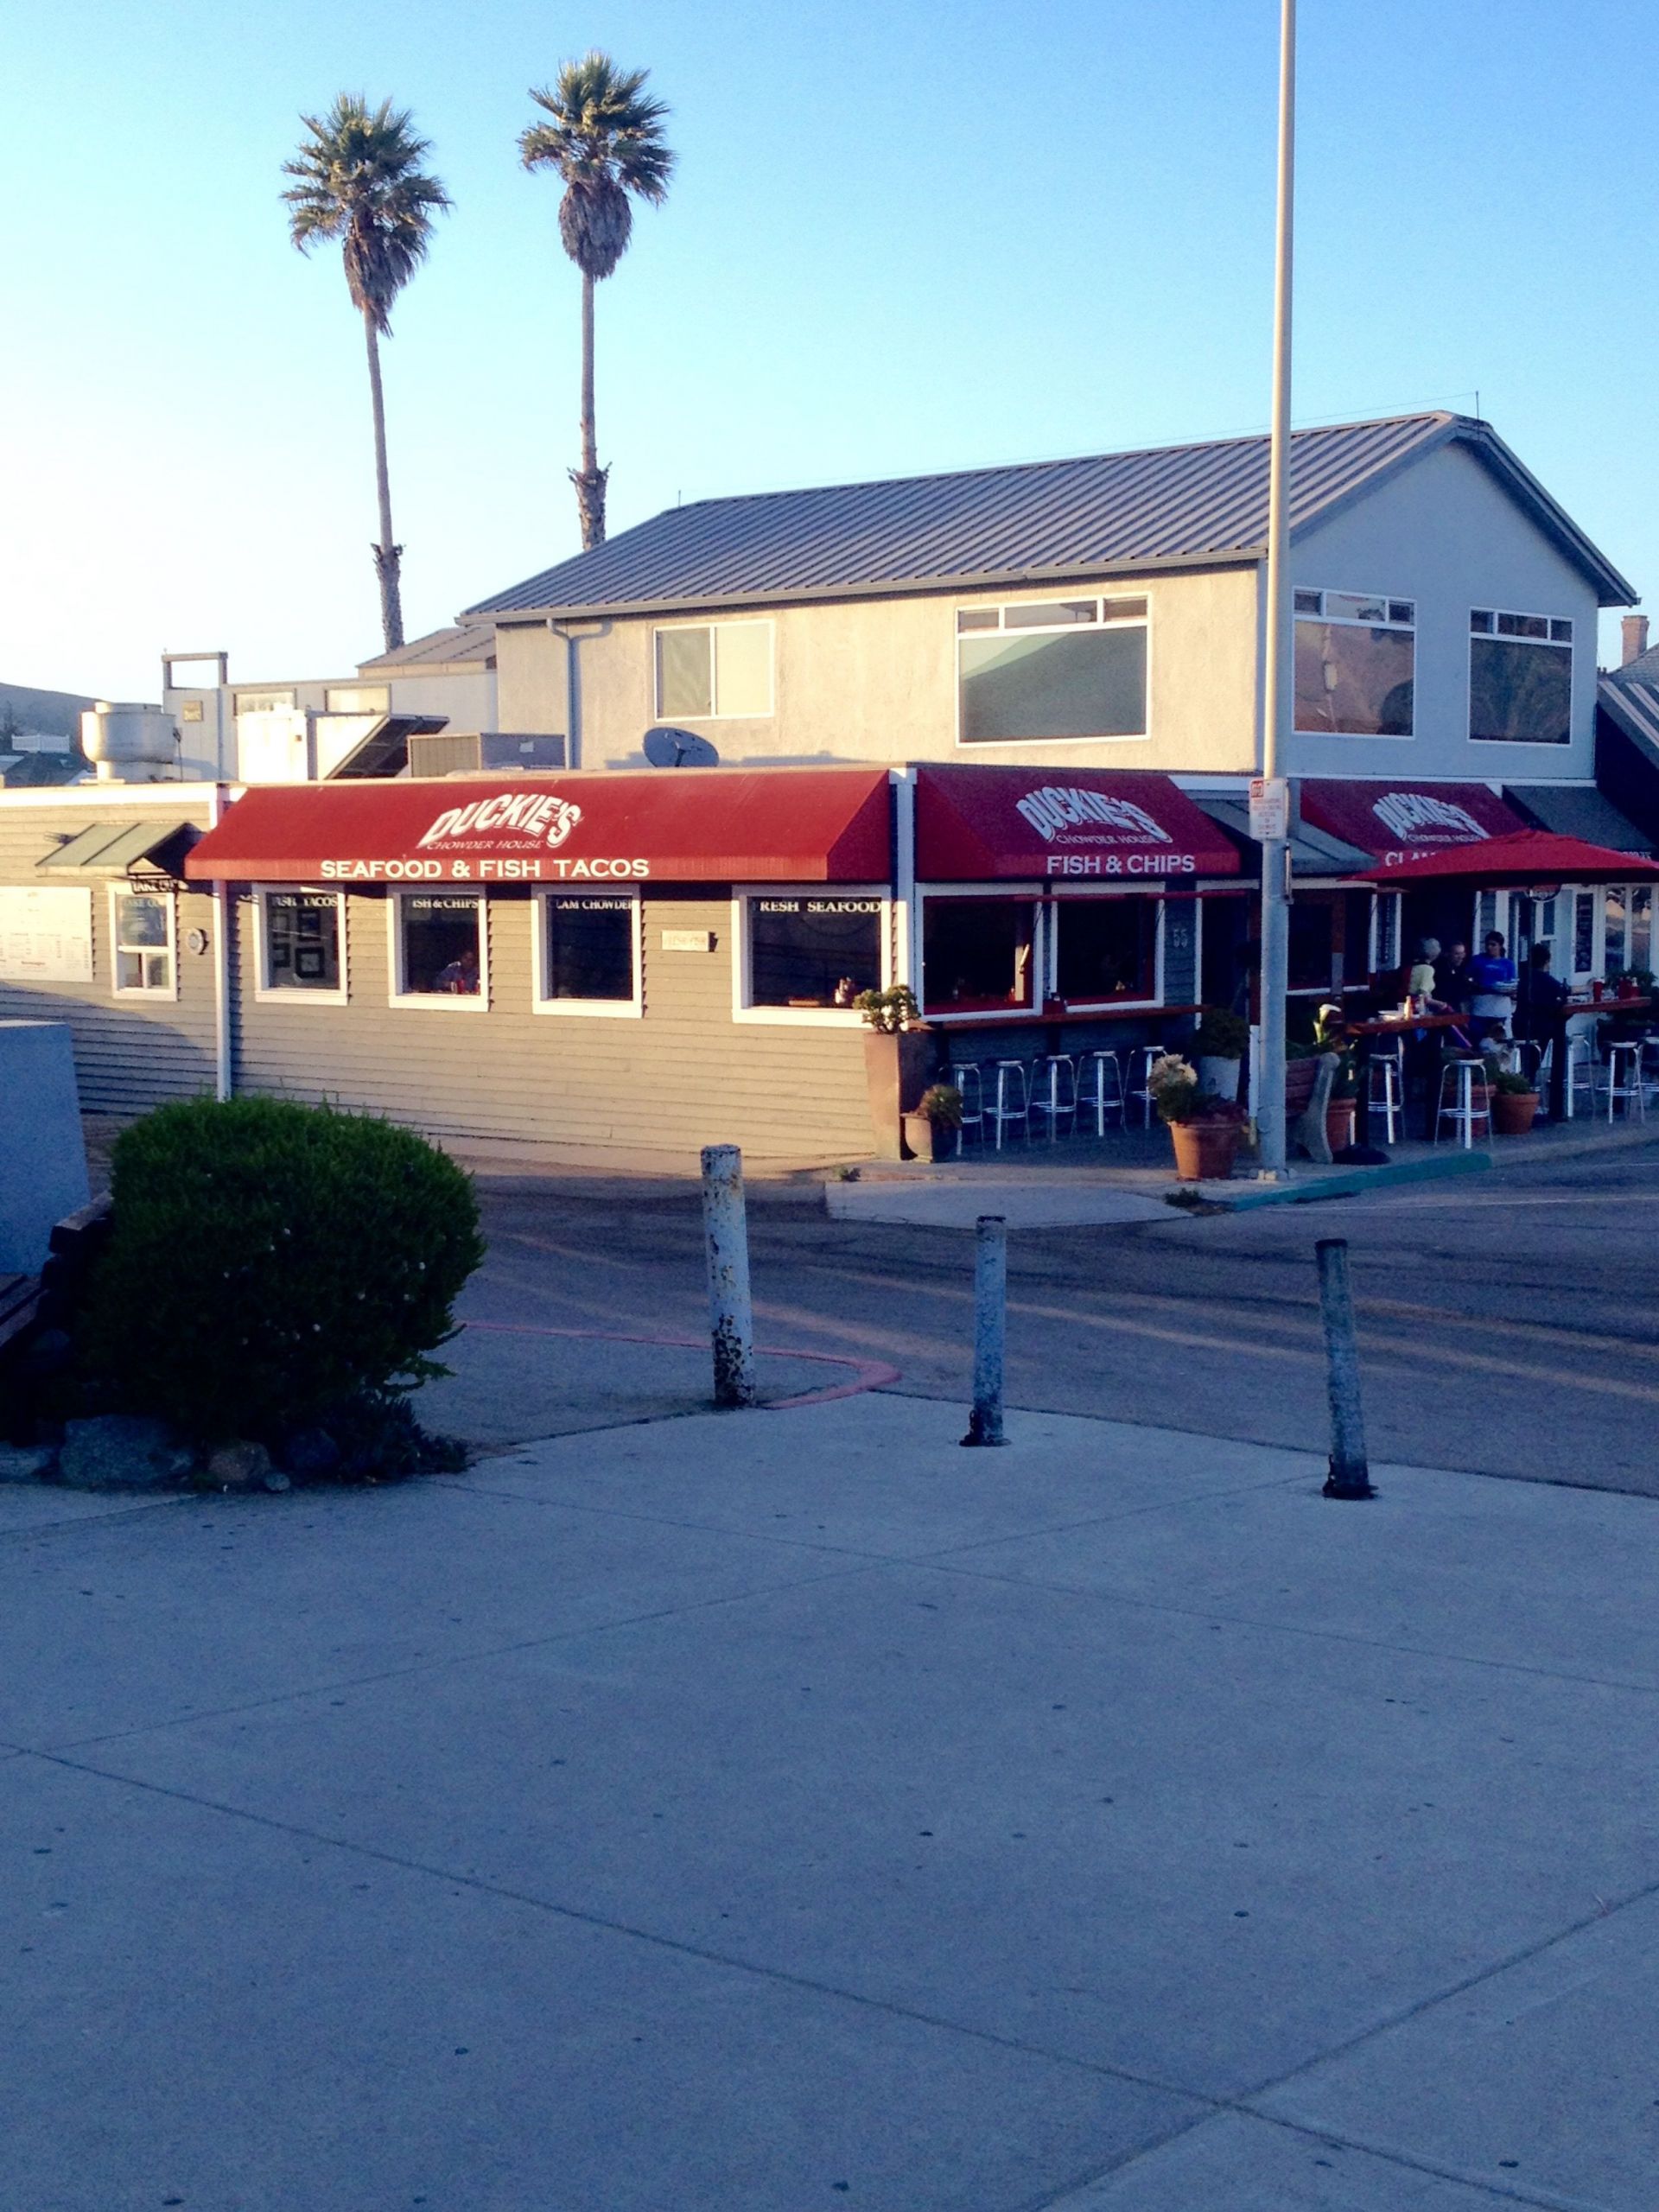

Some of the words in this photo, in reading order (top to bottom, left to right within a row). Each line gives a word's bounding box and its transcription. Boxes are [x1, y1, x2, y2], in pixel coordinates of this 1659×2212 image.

[1016, 786, 1173, 843] DUCKIE'S
[416, 793, 584, 849] DUCKIE'S
[427, 840, 494, 850] CHOWDER
[496, 839, 544, 850] HOUSE
[1056, 834, 1117, 845] CHOWDER
[321, 860, 442, 879] SEAFOOD
[451, 859, 472, 878] &
[479, 858, 542, 879] FISH
[553, 858, 650, 878] TACOS
[1046, 855, 1102, 874] FISH
[1106, 855, 1122, 874] &
[1127, 854, 1196, 874] CHIPS
[271, 896, 297, 907] ISH
[304, 896, 338, 908] TACOS
[412, 899, 432, 909] ISH
[433, 899, 442, 909] &
[443, 899, 479, 909] CHIPS
[556, 899, 580, 910] LAM
[760, 901, 800, 912] RESH
[807, 901, 881, 913] SEAFOOD
